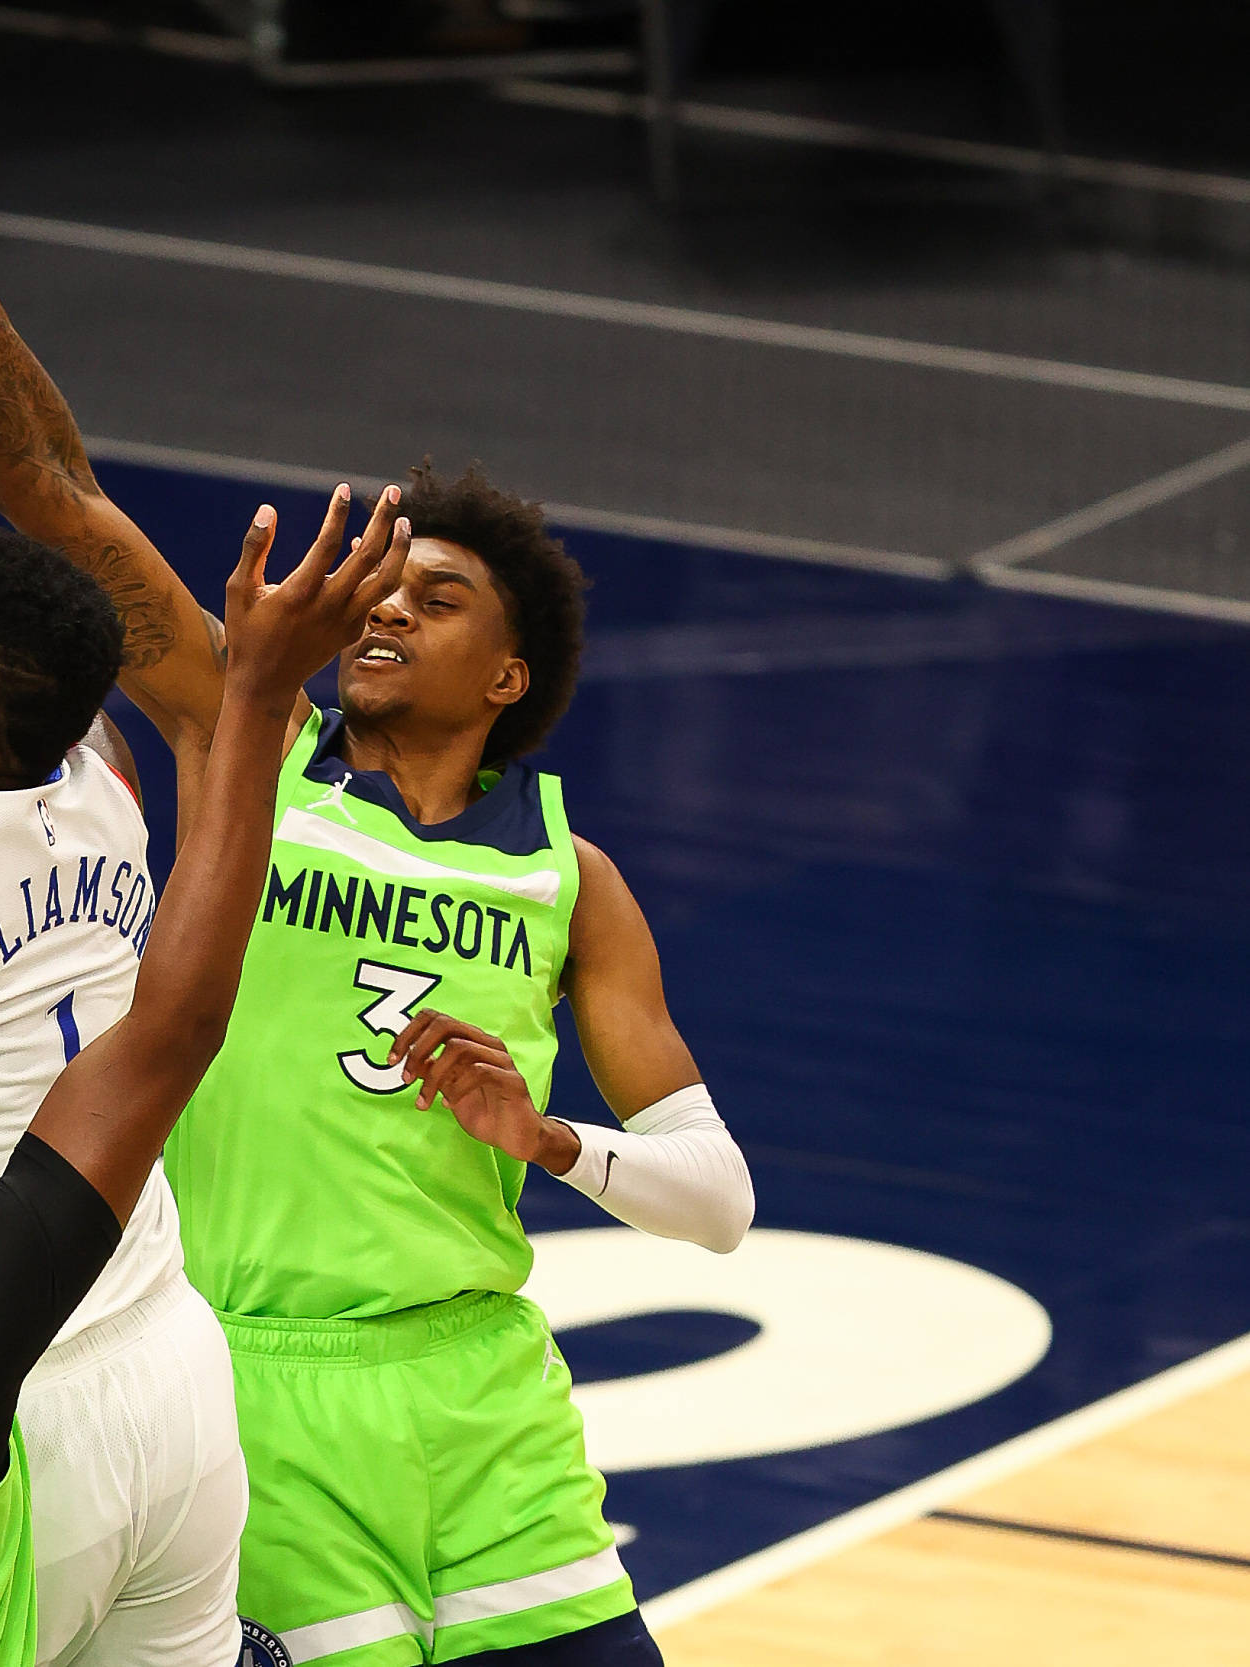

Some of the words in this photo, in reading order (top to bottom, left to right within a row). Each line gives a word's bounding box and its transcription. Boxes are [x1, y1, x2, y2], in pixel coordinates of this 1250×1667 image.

[262, 863, 532, 977] MINNESOTA
[46, 989, 81, 1066] 1
[337, 958, 442, 1096] 3
[243, 1623, 288, 1667] MBERWO
